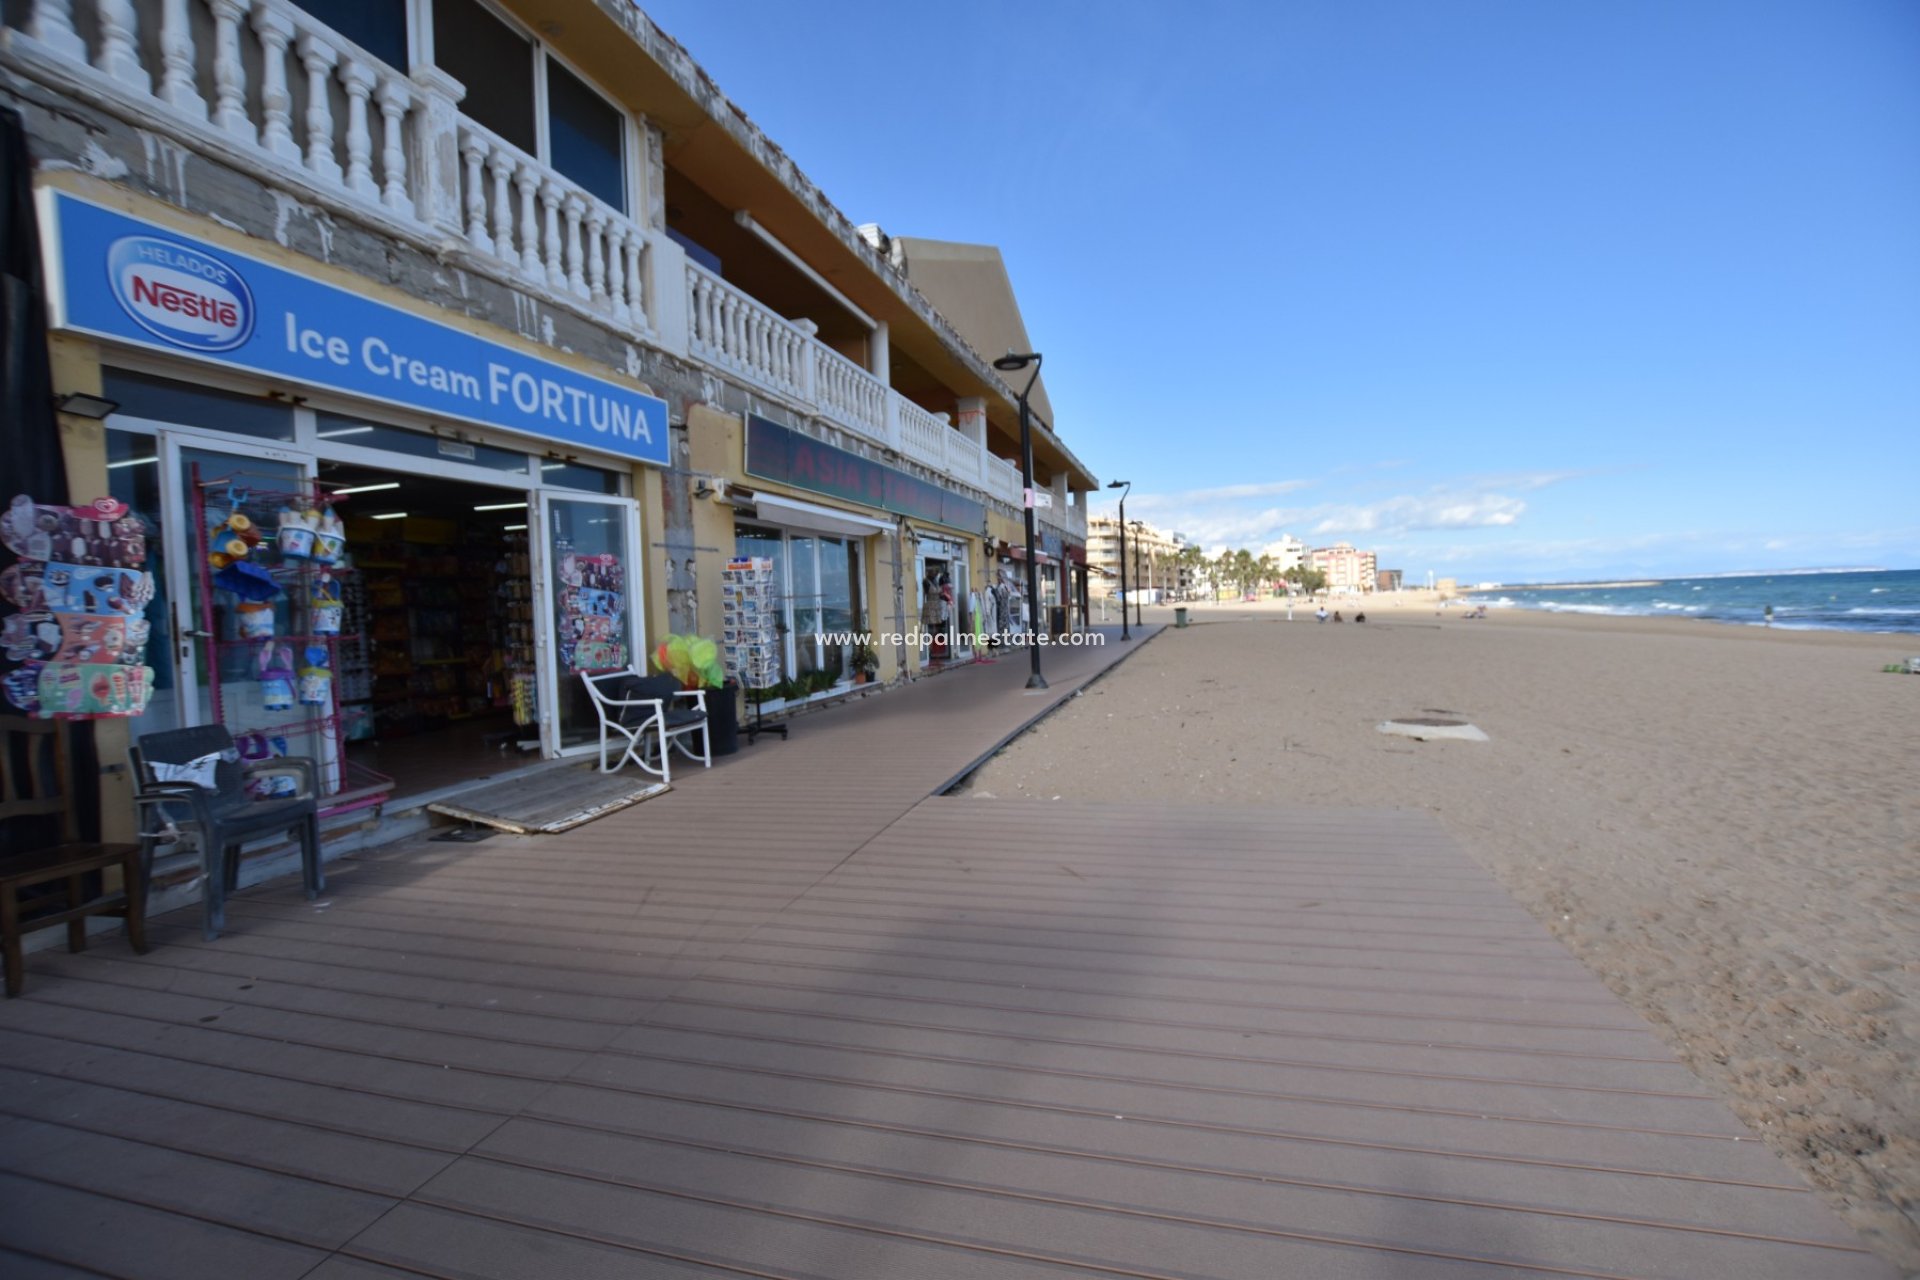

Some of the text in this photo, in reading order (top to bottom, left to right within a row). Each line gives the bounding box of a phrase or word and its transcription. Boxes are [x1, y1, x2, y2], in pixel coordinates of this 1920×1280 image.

[137, 244, 228, 285] HELADOS
[285, 311, 653, 445] Ice Cream FORTUNA
[795, 446, 861, 492] ASIA
